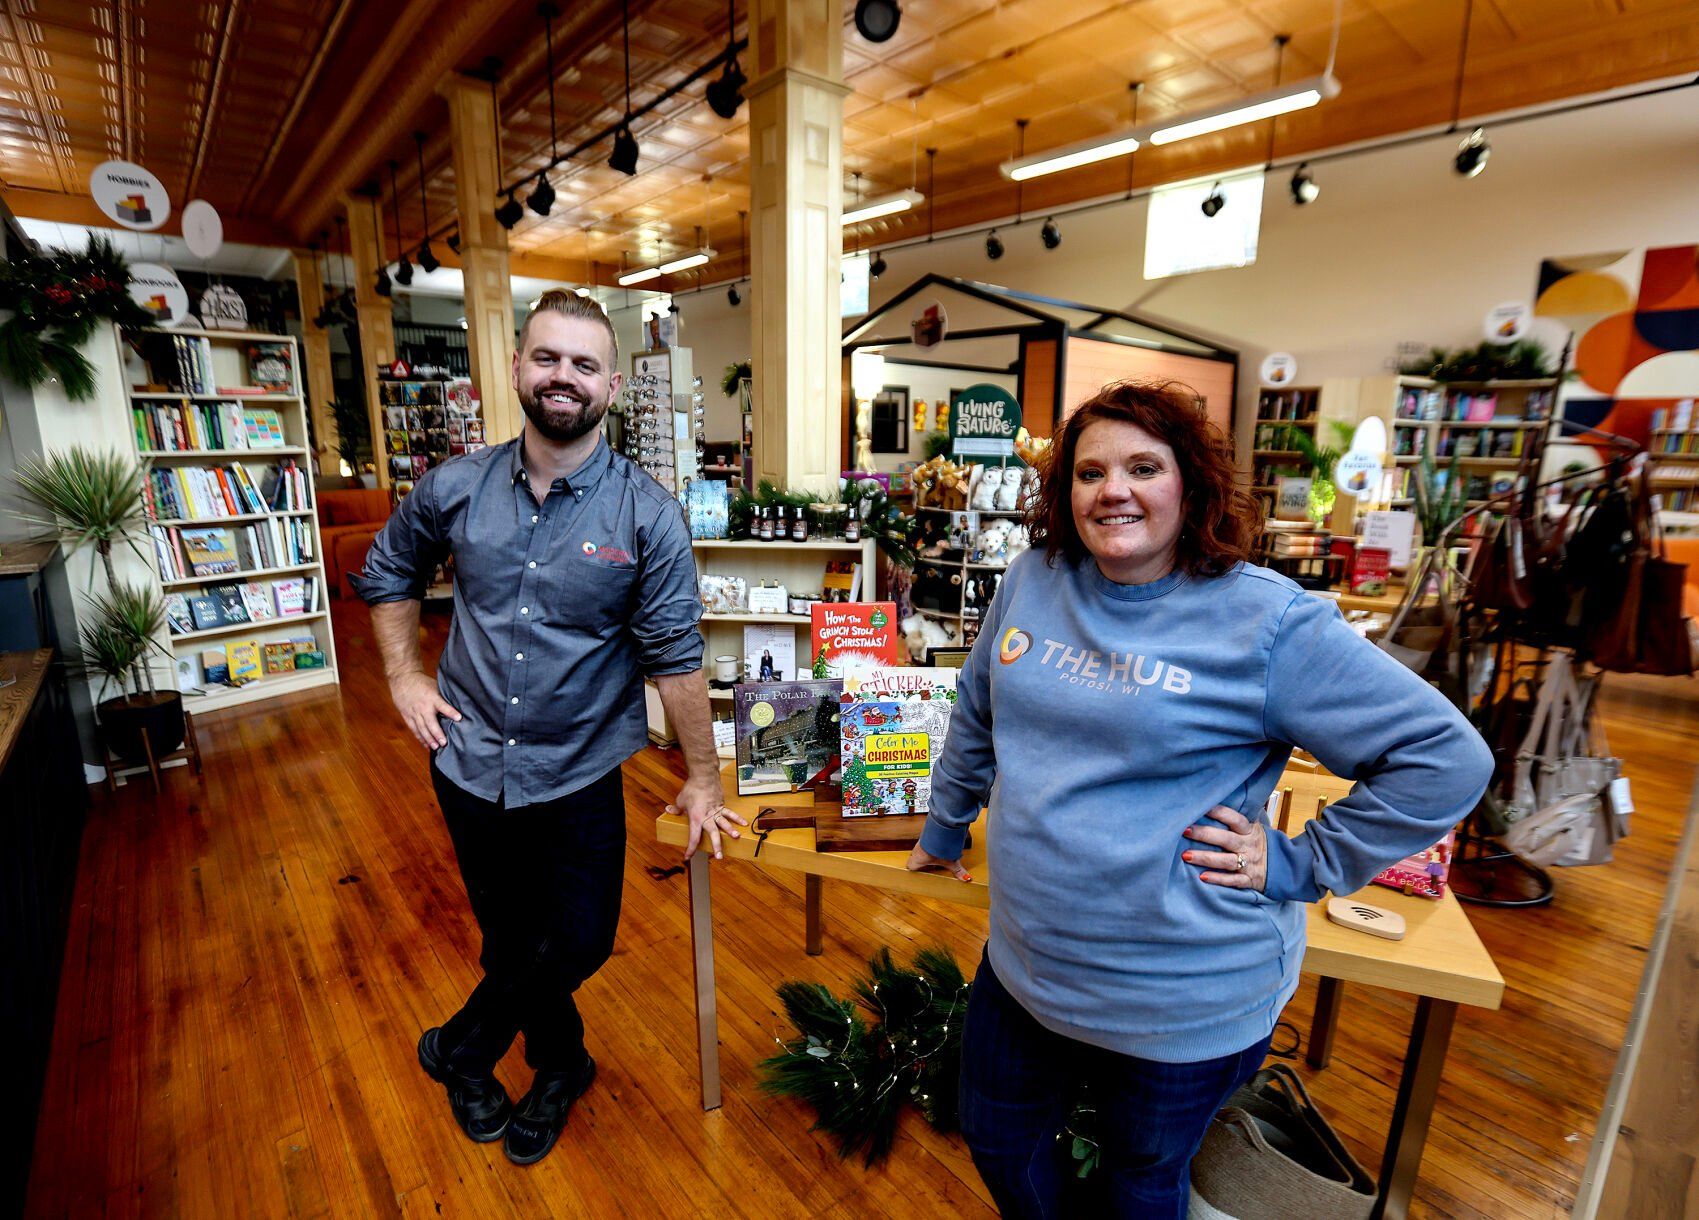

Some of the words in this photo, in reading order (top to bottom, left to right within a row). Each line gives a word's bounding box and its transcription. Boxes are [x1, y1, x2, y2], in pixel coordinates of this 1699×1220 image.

[957, 399, 1005, 418] LIVING
[956, 416, 1013, 436] NATURE
[847, 615, 861, 623] The
[819, 626, 849, 639] GRINCH
[851, 626, 874, 636] STOLE
[834, 634, 887, 648] CHRISTMAS!
[1040, 639, 1102, 679] THE
[1108, 652, 1192, 694] HUB
[872, 670, 884, 679] MY
[860, 675, 923, 692] STICKER
[1059, 673, 1113, 693] POTOSI,
[1122, 685, 1140, 696] WI
[745, 692, 769, 701] THE
[772, 690, 807, 700] POLAR
[876, 737, 897, 749] Color
[902, 737, 919, 748] Me
[868, 749, 927, 762] CHRISTMAS
